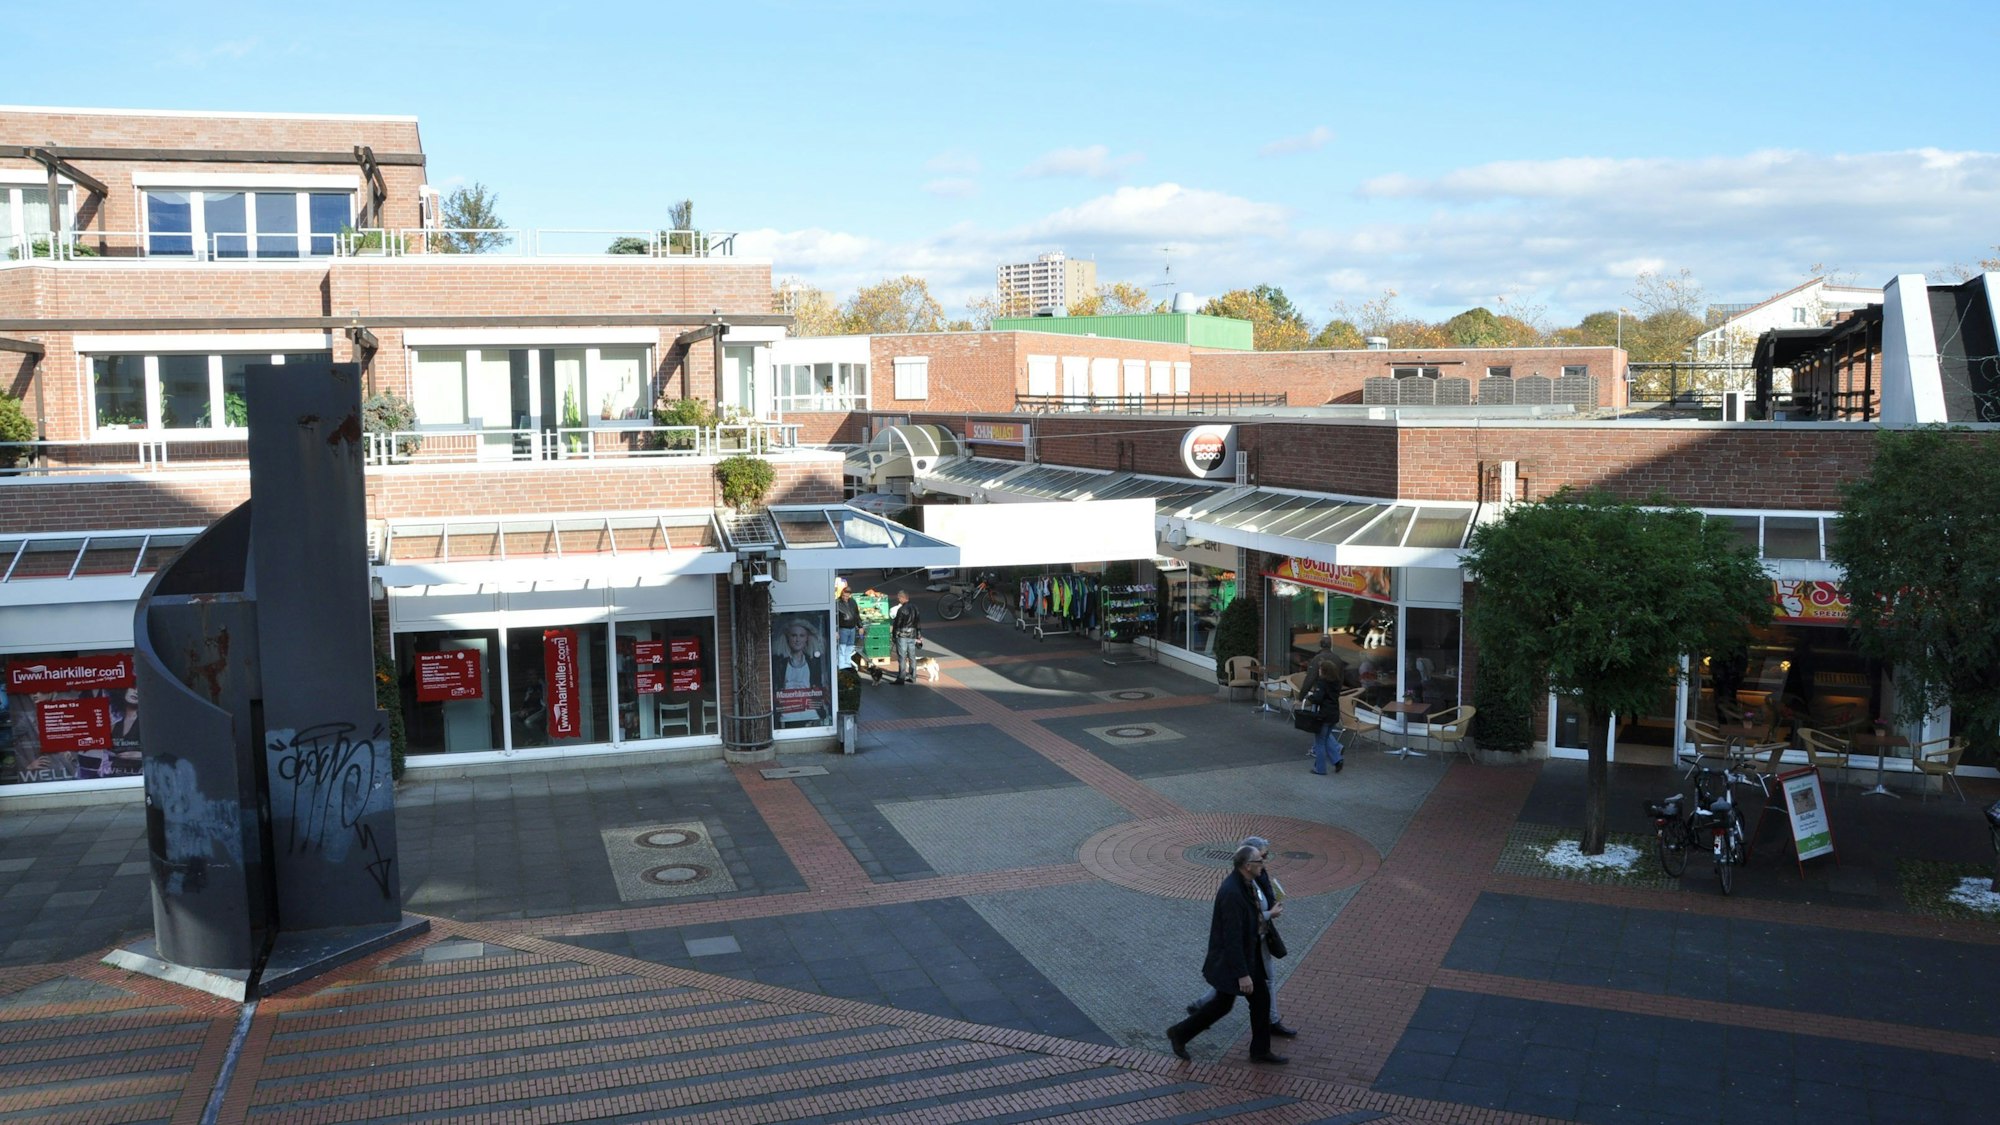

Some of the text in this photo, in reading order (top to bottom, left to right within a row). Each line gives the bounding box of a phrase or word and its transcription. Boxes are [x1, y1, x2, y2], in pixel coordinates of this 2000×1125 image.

[1193, 444, 1223, 452] SPORT
[1195, 452, 1221, 460] 2000
[20, 768, 79, 782] WELL
